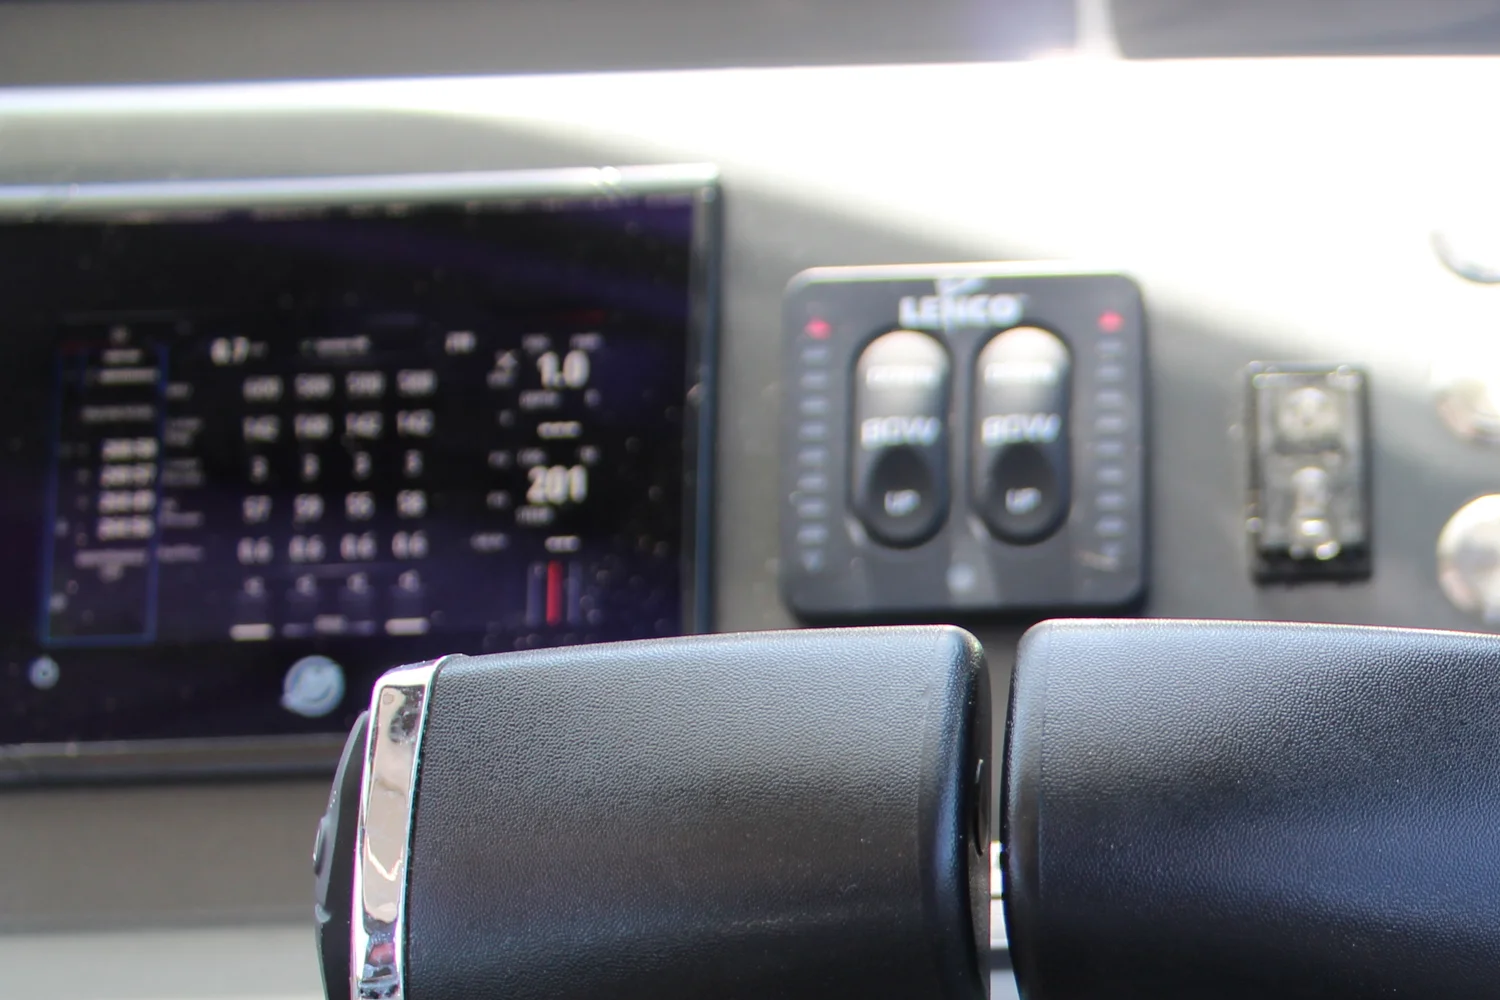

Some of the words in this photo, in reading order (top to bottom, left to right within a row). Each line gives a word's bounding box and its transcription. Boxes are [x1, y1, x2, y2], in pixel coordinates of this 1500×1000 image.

[898, 295, 1022, 328] LENCO
[884, 489, 922, 517] UP
[1005, 487, 1042, 515] UP
